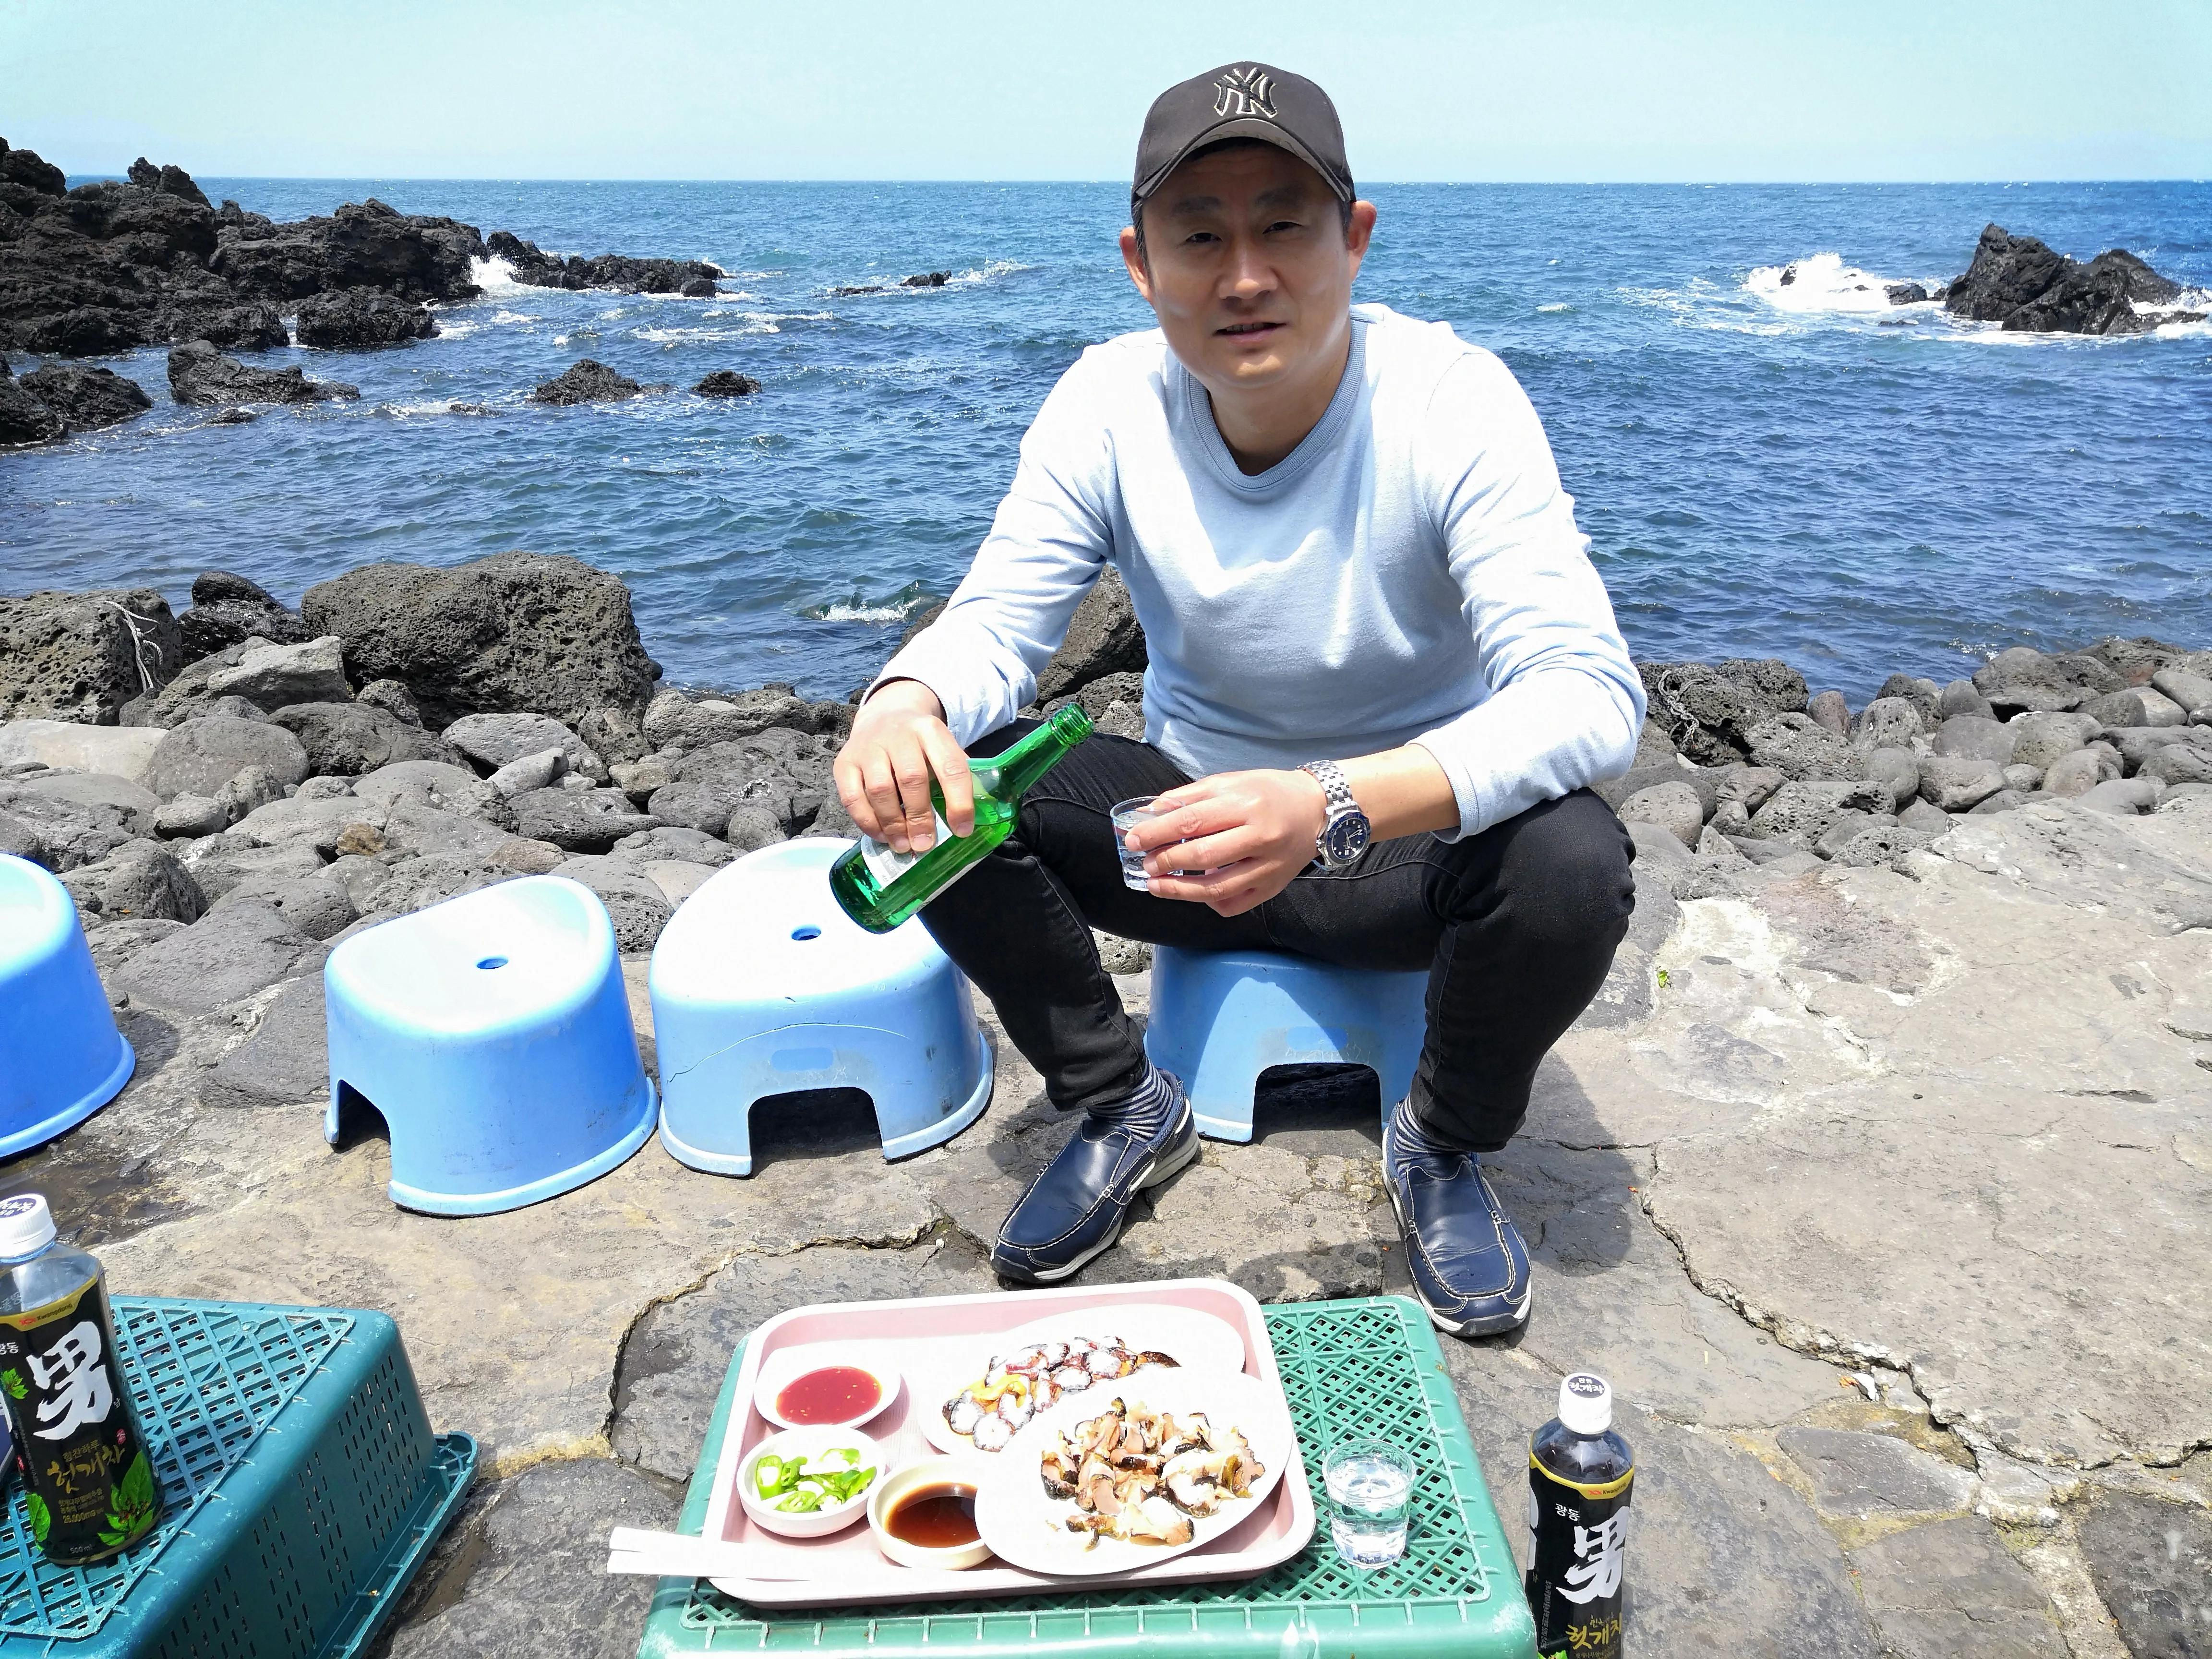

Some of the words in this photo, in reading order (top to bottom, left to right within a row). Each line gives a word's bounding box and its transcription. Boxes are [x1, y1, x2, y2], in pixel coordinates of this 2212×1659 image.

[37, 1303, 72, 1321] Kwangdong
[26, 1322, 113, 1440] 男
[1568, 1382, 1604, 1394] 헛개차
[47, 1445, 125, 1494] 헛개차
[1555, 1503, 1580, 1521] 광동
[1555, 1506, 1630, 1604] 男
